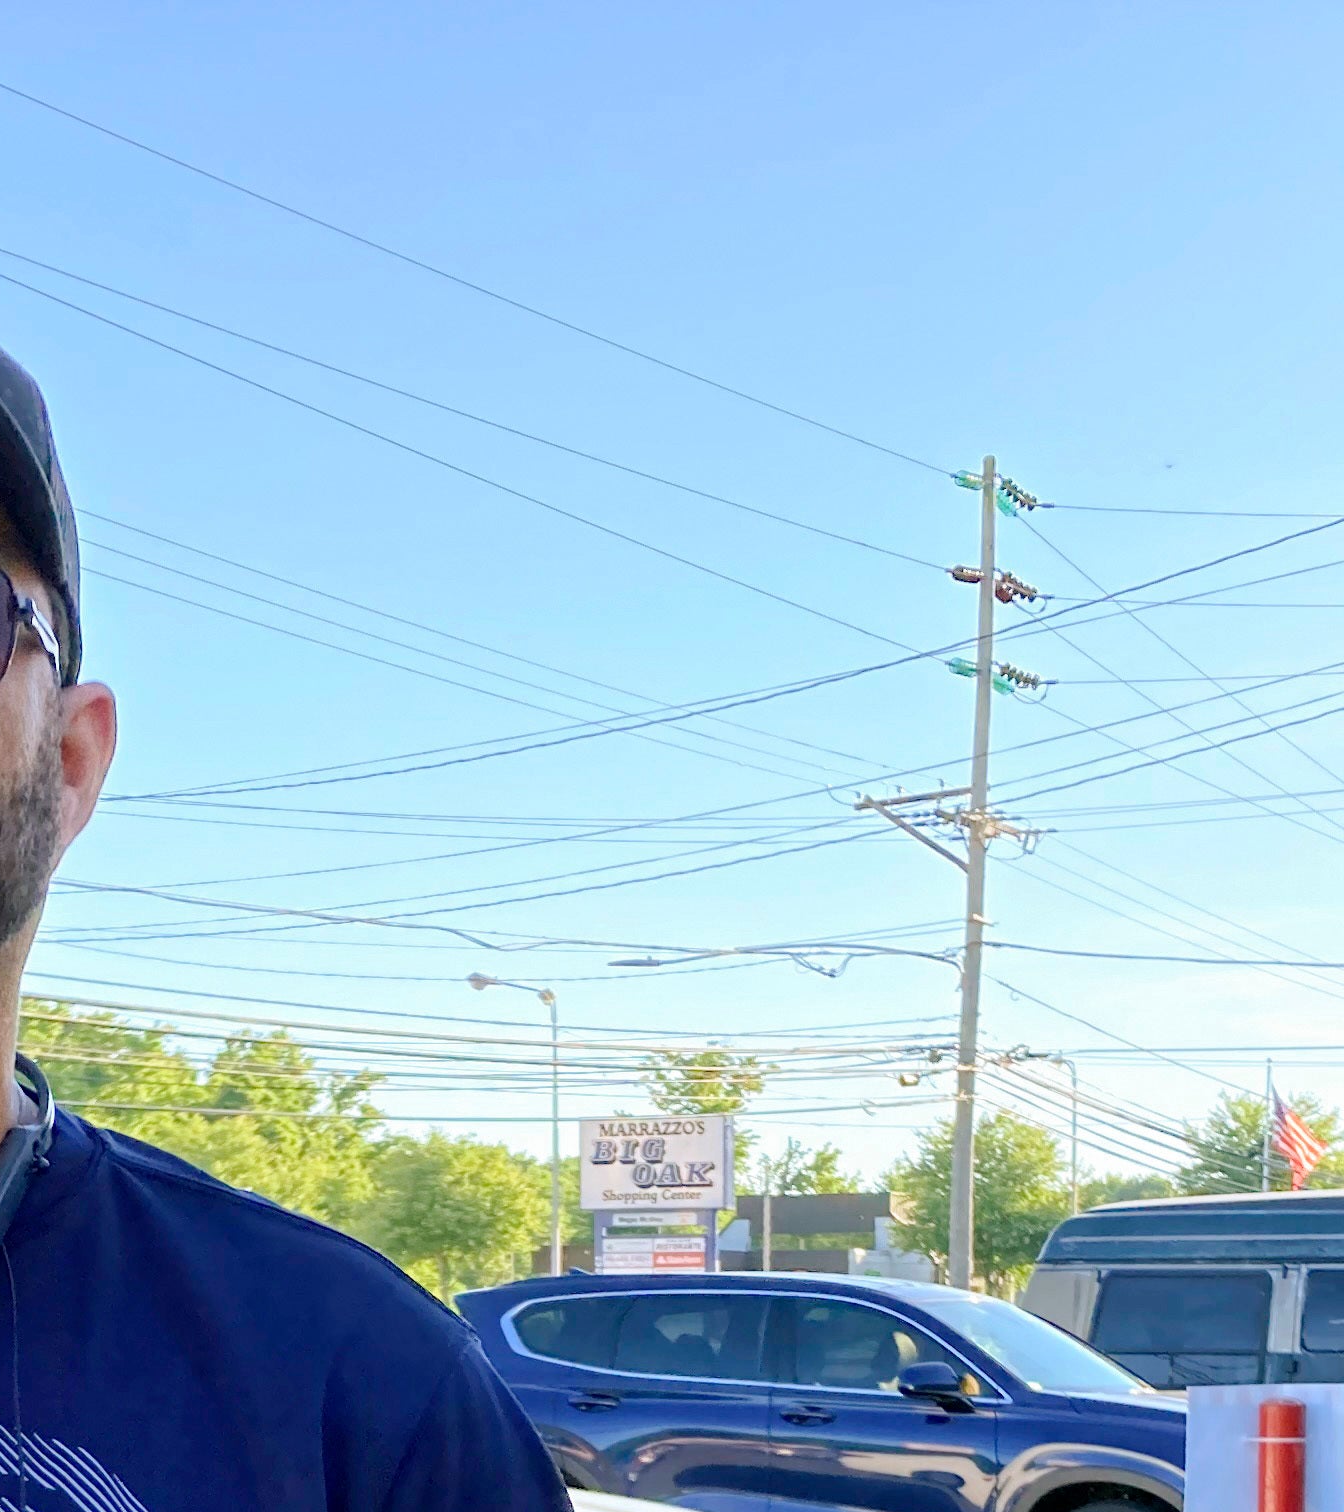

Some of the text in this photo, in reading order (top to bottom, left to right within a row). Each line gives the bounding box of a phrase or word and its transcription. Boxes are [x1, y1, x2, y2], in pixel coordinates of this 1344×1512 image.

[600, 1121, 705, 1137] MARRAZZO'S
[592, 1138, 666, 1164] BIG
[632, 1162, 714, 1188] OAK
[602, 1189, 702, 1204] Shopping Center
